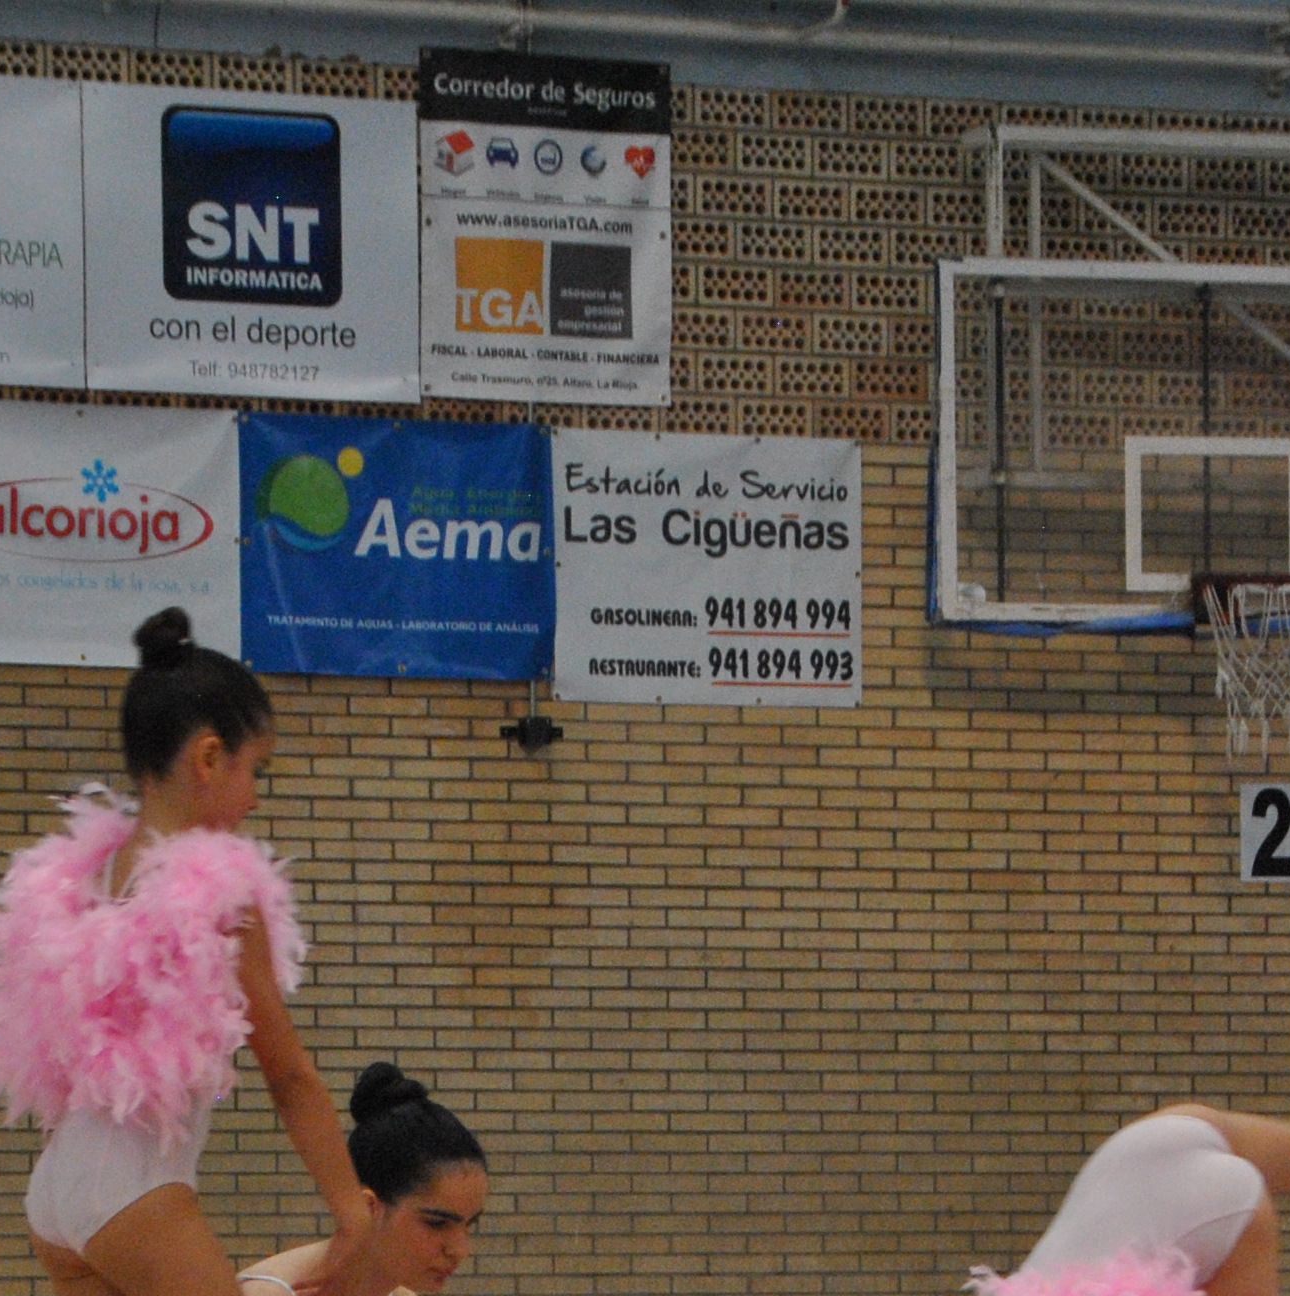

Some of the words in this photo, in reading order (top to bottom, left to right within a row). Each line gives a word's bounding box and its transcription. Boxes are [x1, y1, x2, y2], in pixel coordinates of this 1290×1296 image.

[434, 72, 535, 100] Corredor
[541, 79, 566, 100] de
[573, 82, 657, 112] Seguros
[185, 200, 320, 265] SNT
[456, 211, 633, 235] www.asesoriaTGA.com
[186, 265, 324, 292] INFORMATICA
[609, 289, 623, 301] de
[456, 288, 545, 329] TGA
[150, 318, 201, 342] con
[212, 316, 236, 342] el
[247, 316, 357, 350] deporte
[431, 343, 468, 357] FISCAL
[477, 346, 528, 360] LABORAL
[537, 349, 589, 362] CONTABLE
[597, 352, 660, 365] FINANCIERA
[228, 361, 320, 382] 948782127
[451, 372, 479, 384] Calle
[597, 379, 610, 389] La
[565, 461, 681, 496] Estación
[695, 470, 729, 498] de
[740, 469, 849, 502] Servicio
[354, 498, 541, 561] Aema
[564, 505, 637, 545] Las
[662, 508, 851, 558] Cigüeñas
[268, 615, 339, 629] TRATAMIENTO
[340, 617, 354, 628] DE
[357, 618, 393, 630] AGUAS
[402, 620, 477, 632] LABORATORIO
[479, 622, 493, 632] DE
[590, 607, 698, 627] GASOLINERA:
[706, 596, 746, 628] 941
[754, 598, 798, 630] 894
[806, 598, 852, 631] 994
[589, 657, 702, 679] RESTAURANTE:
[709, 647, 750, 679] 941
[758, 648, 802, 680] 894
[810, 649, 854, 681] 993
